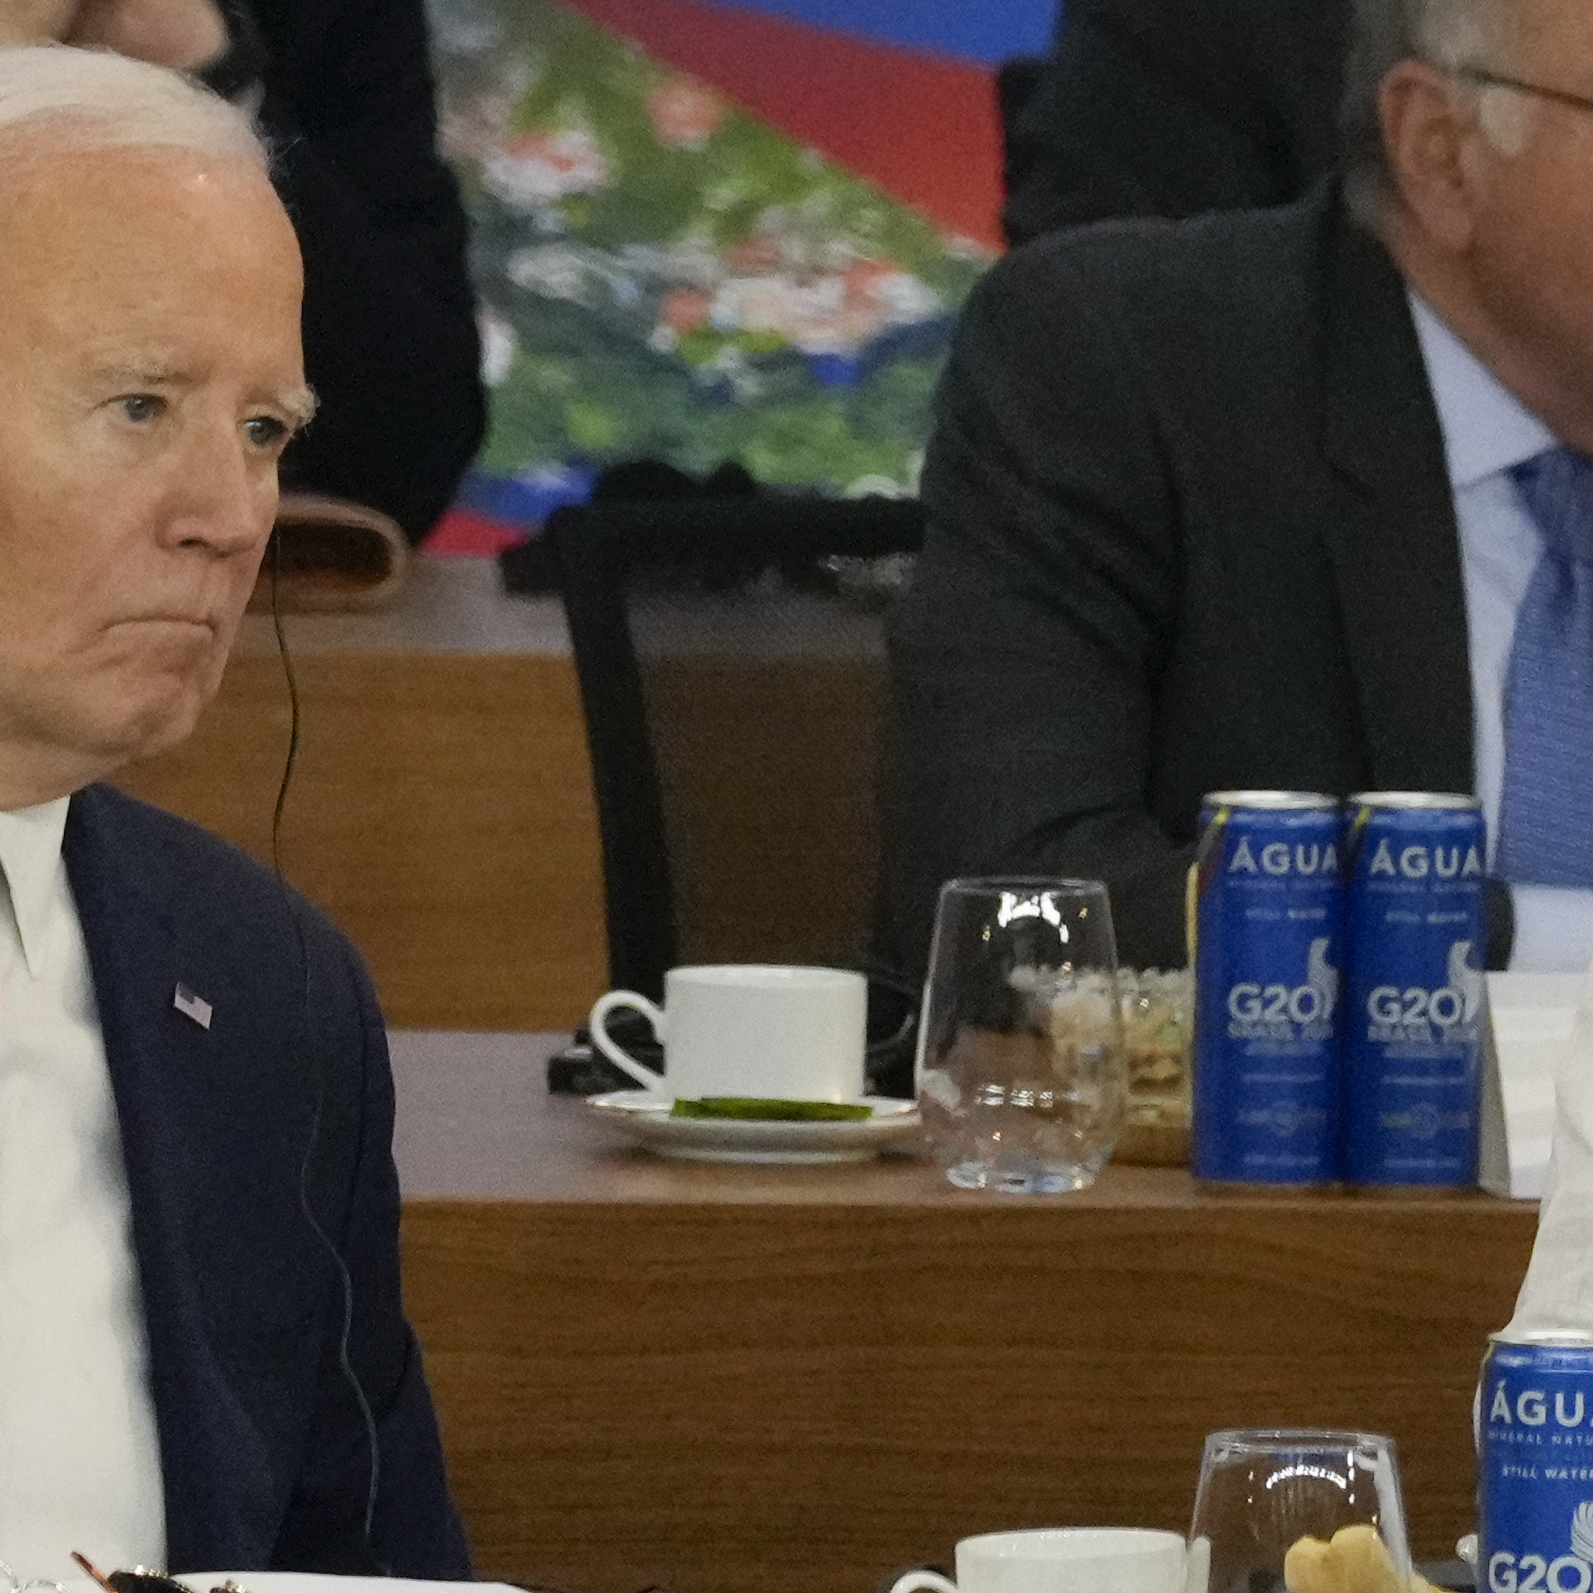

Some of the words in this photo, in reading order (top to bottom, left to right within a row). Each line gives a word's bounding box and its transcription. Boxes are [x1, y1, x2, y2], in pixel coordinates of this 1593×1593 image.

[1228, 835, 1338, 875] ÁGUA
[1370, 837, 1481, 878] ÁGUA
[1228, 982, 1321, 1024] G20
[1367, 985, 1461, 1026] G20
[1502, 1465, 1537, 1479] STILL
[1488, 1551, 1592, 1593] G20
